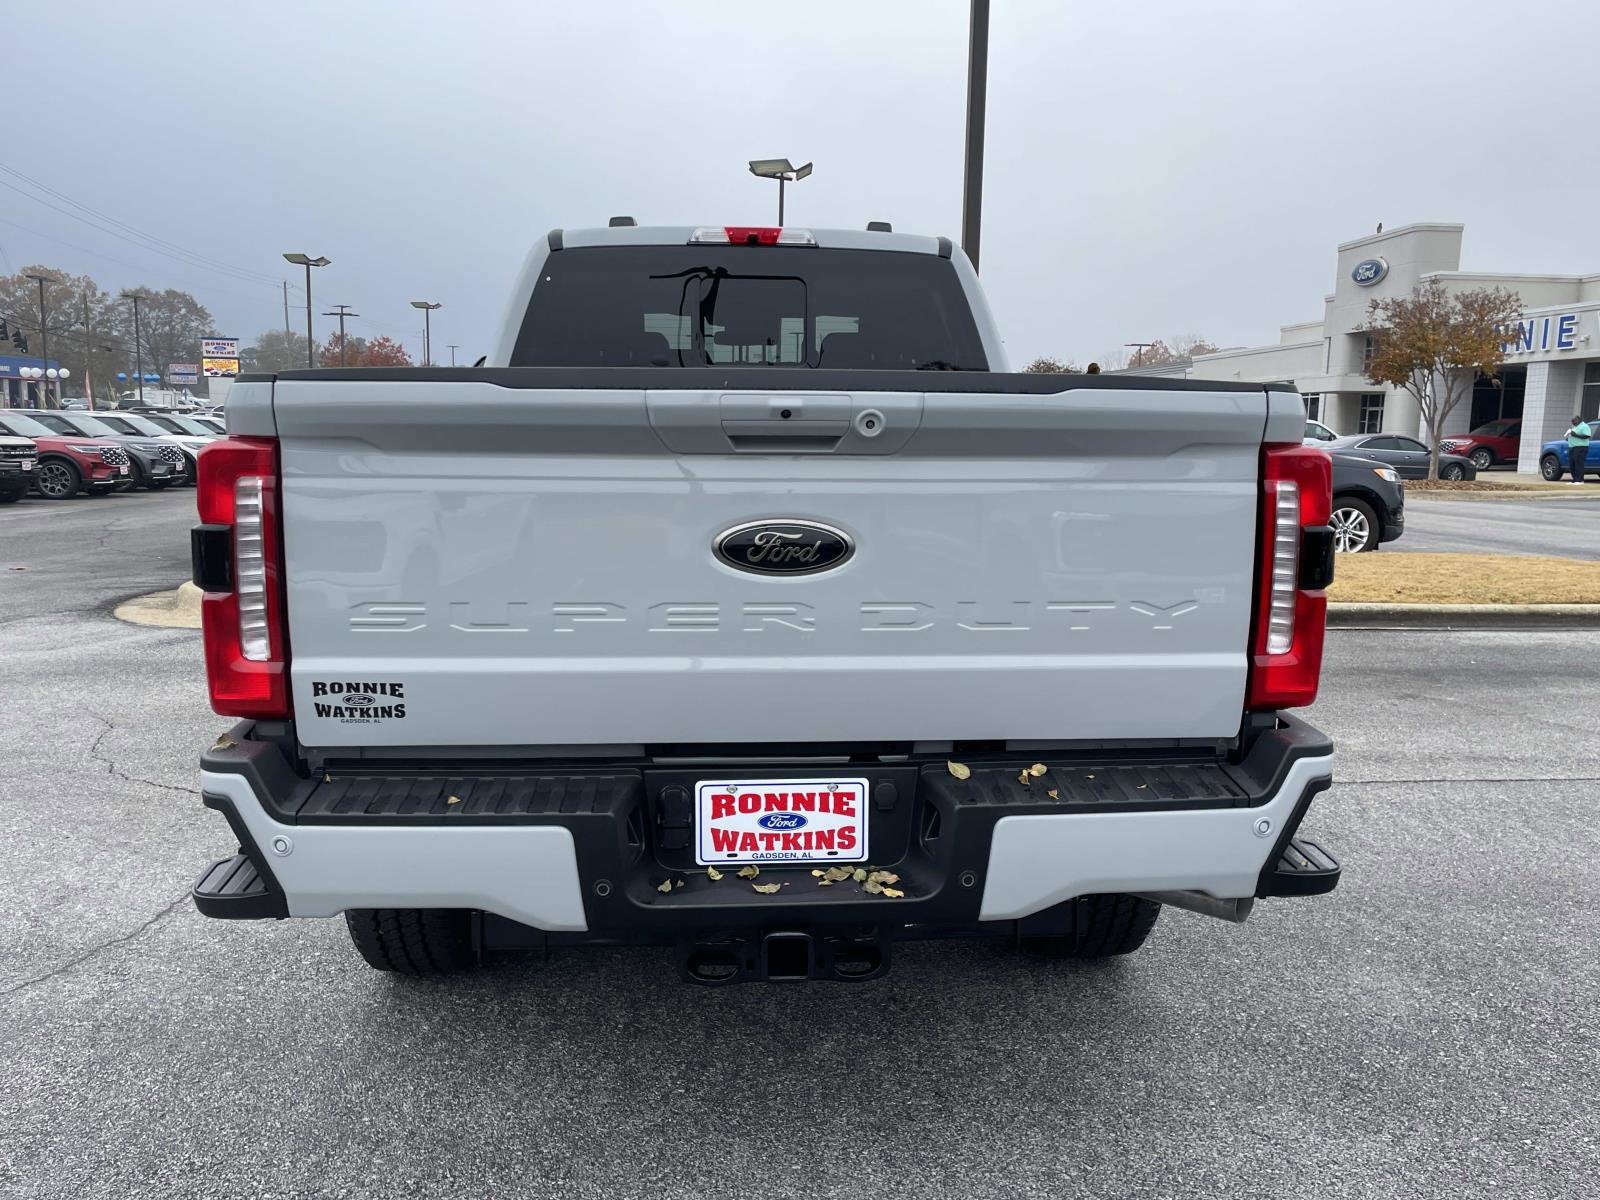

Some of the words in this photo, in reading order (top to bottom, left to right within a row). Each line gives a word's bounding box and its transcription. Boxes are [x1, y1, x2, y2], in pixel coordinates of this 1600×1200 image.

[1357, 264, 1376, 281] Ford
[746, 531, 822, 563] Ford
[350, 601, 816, 632] SUPER
[860, 600, 1199, 632] DUTY
[312, 681, 405, 698] RONNIE
[314, 702, 406, 719] WATKINS
[711, 792, 855, 820] RONNIE
[767, 815, 798, 828] Ford
[710, 825, 857, 852] WATKINS
[751, 852, 800, 860] GADSDEN,
[801, 851, 814, 859] AL
